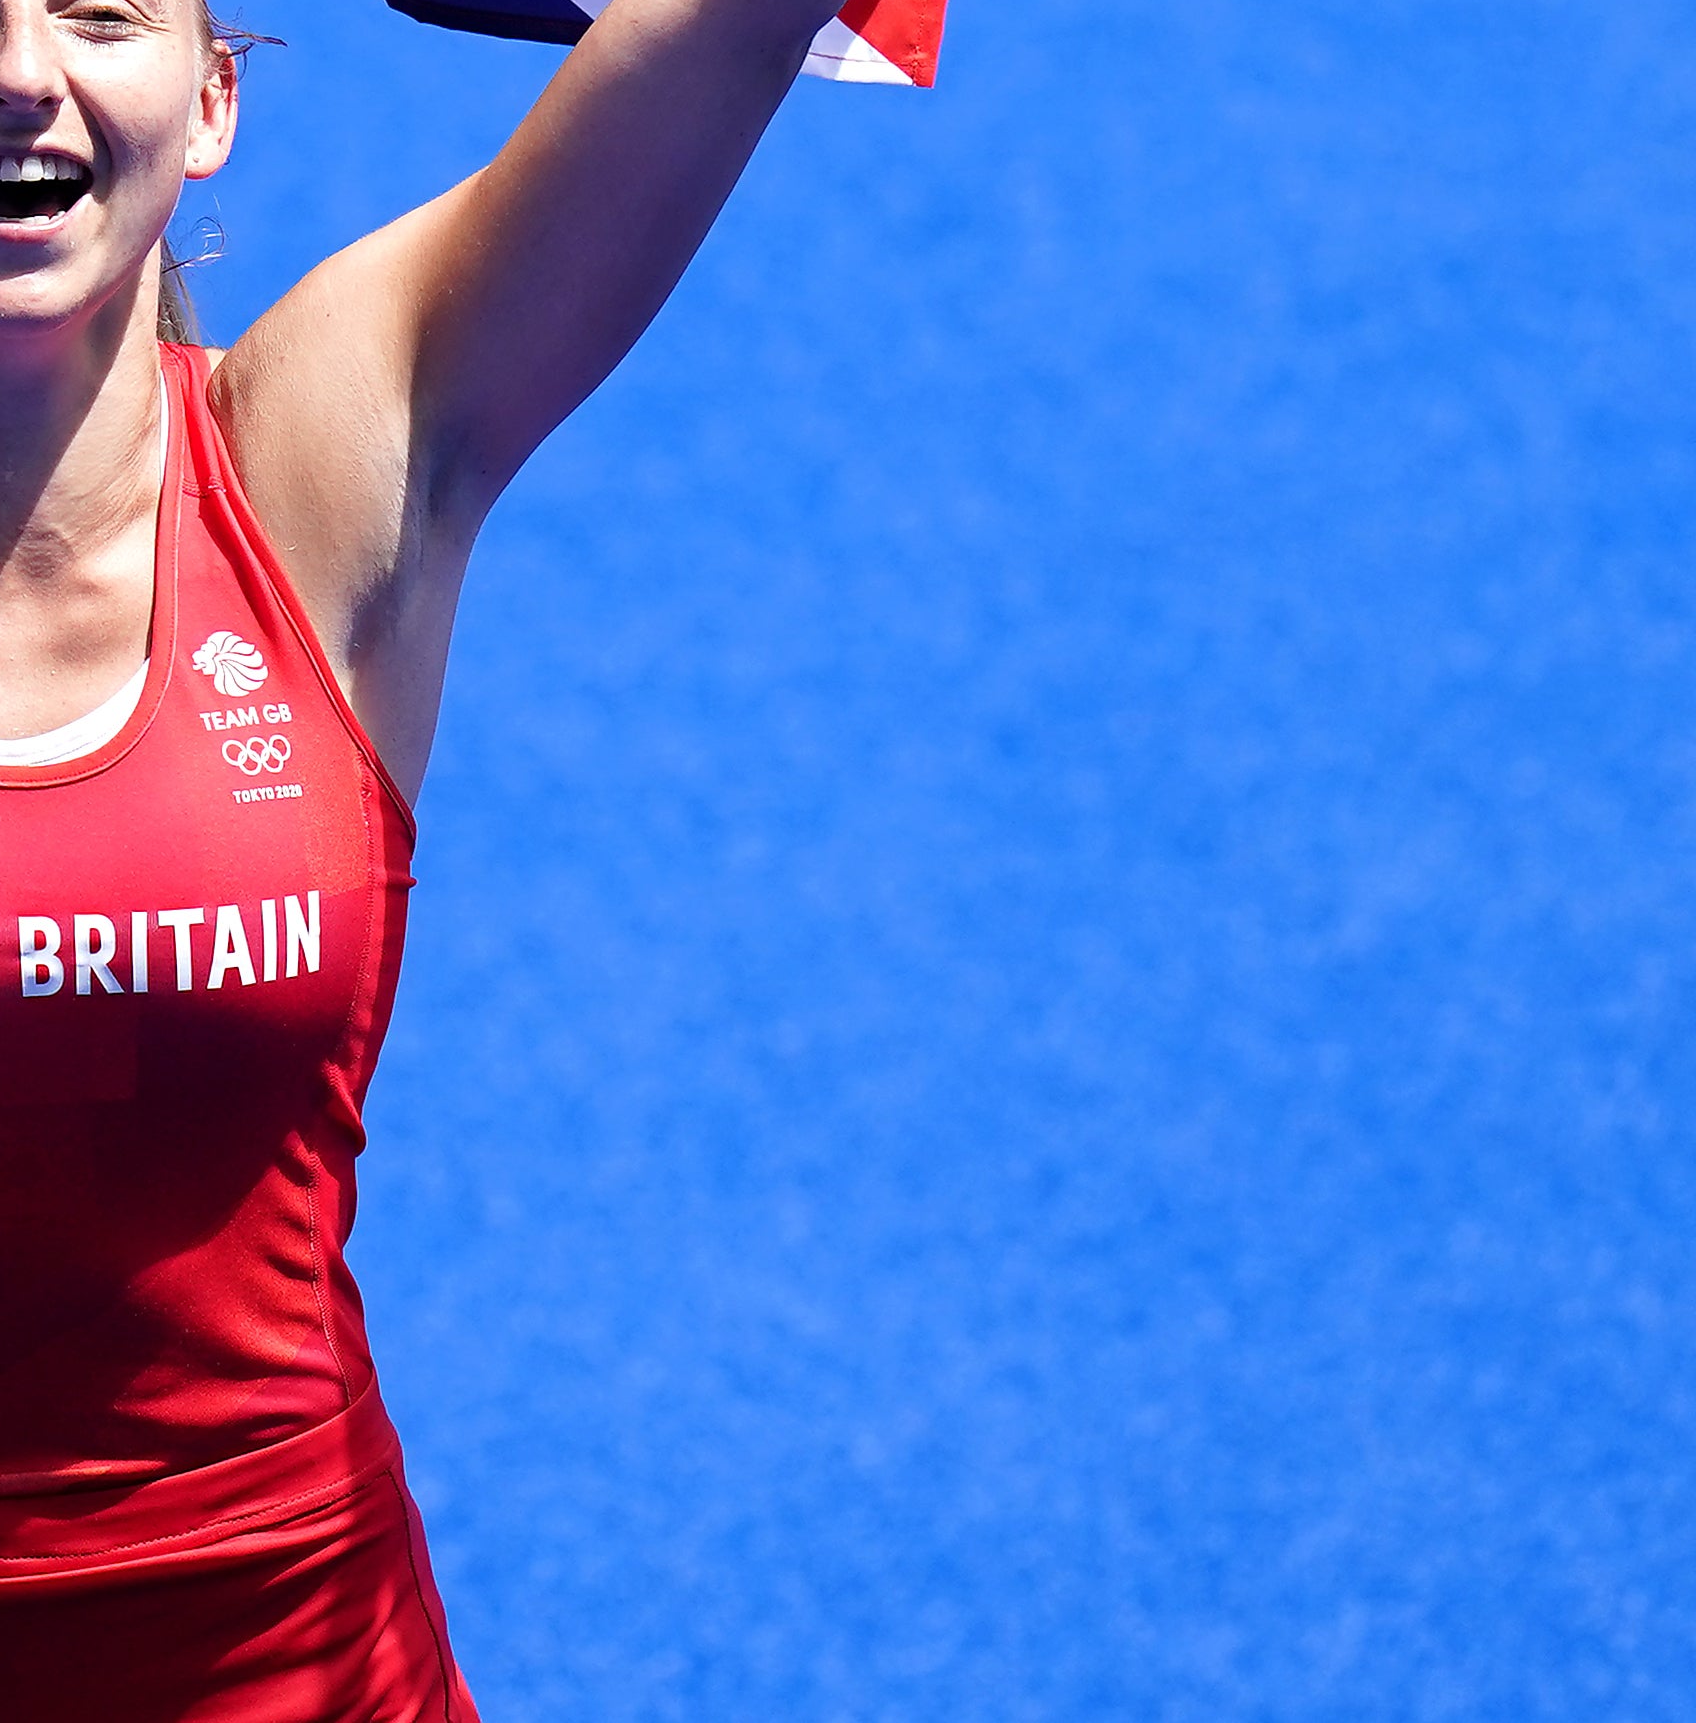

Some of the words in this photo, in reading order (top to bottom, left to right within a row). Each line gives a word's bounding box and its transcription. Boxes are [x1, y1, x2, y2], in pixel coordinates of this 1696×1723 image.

[199, 706, 260, 731] TEAM
[262, 703, 293, 724] GB
[232, 787, 275, 804] TOKYO
[275, 784, 303, 799] 2020
[17, 888, 322, 998] BRITAIN
